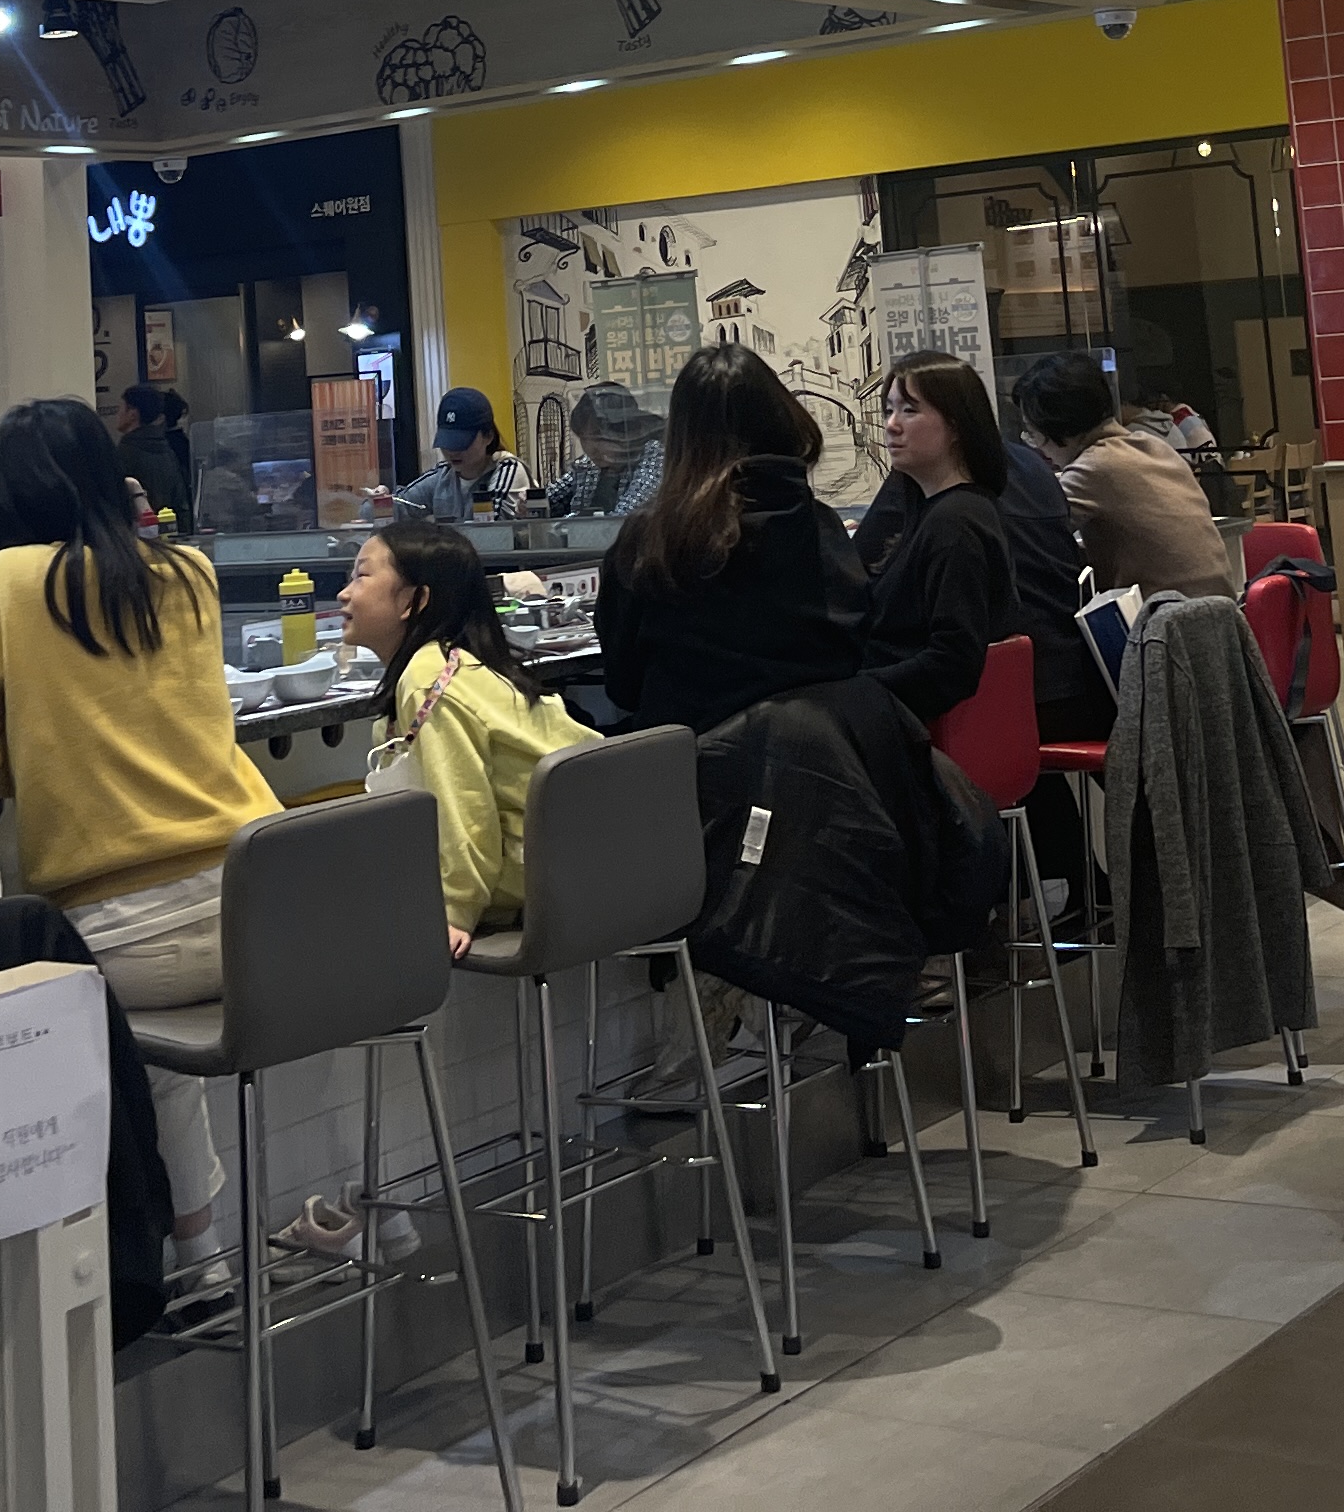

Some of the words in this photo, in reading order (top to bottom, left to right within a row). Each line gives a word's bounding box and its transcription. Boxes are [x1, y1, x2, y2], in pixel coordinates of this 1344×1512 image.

[617, 34, 652, 52] Tasty
[20, 99, 99, 134] Nature
[87, 190, 157, 248] 내뽕
